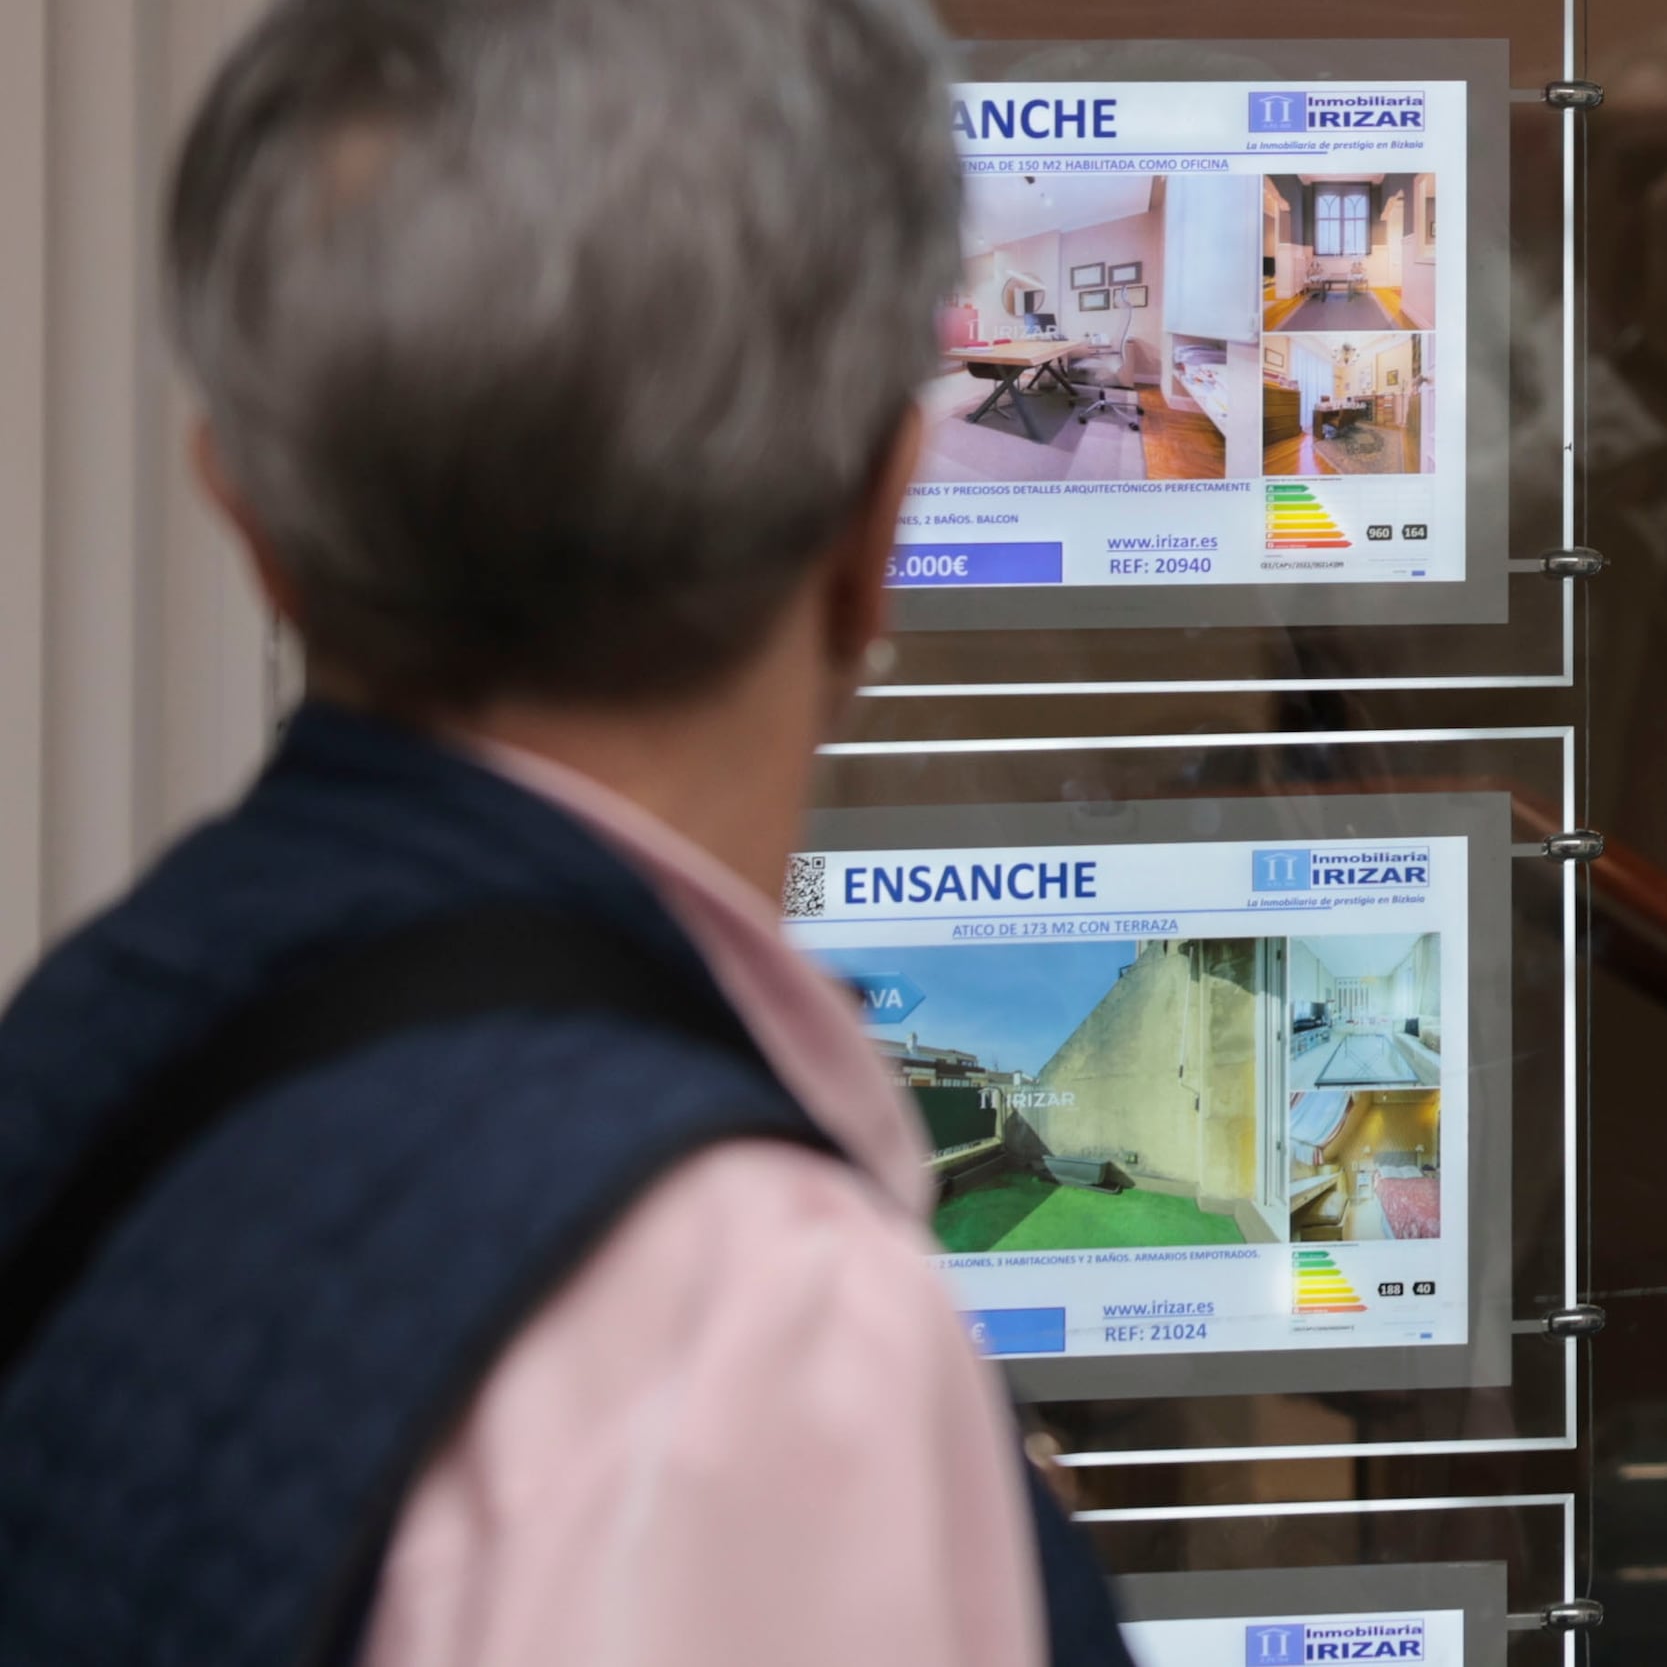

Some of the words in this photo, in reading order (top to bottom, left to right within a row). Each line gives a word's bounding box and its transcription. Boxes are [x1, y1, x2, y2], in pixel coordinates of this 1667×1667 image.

[1307, 95, 1423, 107] Inmobiliaria
[950, 99, 1117, 139] ANCHE
[1307, 110, 1421, 128] IRIZAR
[1106, 532, 1218, 550] www.irizar.es
[1109, 557, 1149, 574] REF:
[1154, 557, 1211, 574] 20940
[1312, 851, 1428, 864] Inmobiliaria
[844, 860, 1096, 905] ENSANCHE
[1312, 866, 1426, 885] IRIZAR
[951, 923, 995, 937] ATICO
[998, 922, 1017, 936] DE
[1022, 921, 1048, 936] 173
[1051, 920, 1075, 935] M2
[1078, 920, 1110, 934] CON
[1113, 918, 1178, 934] TERRAZA
[1102, 1298, 1214, 1317] www.irizar.es
[1104, 1324, 1144, 1342] REF:
[1150, 1322, 1207, 1341] 21024
[1306, 1624, 1423, 1639] Inmobiliaria
[1305, 1639, 1421, 1661] IRIZAR
